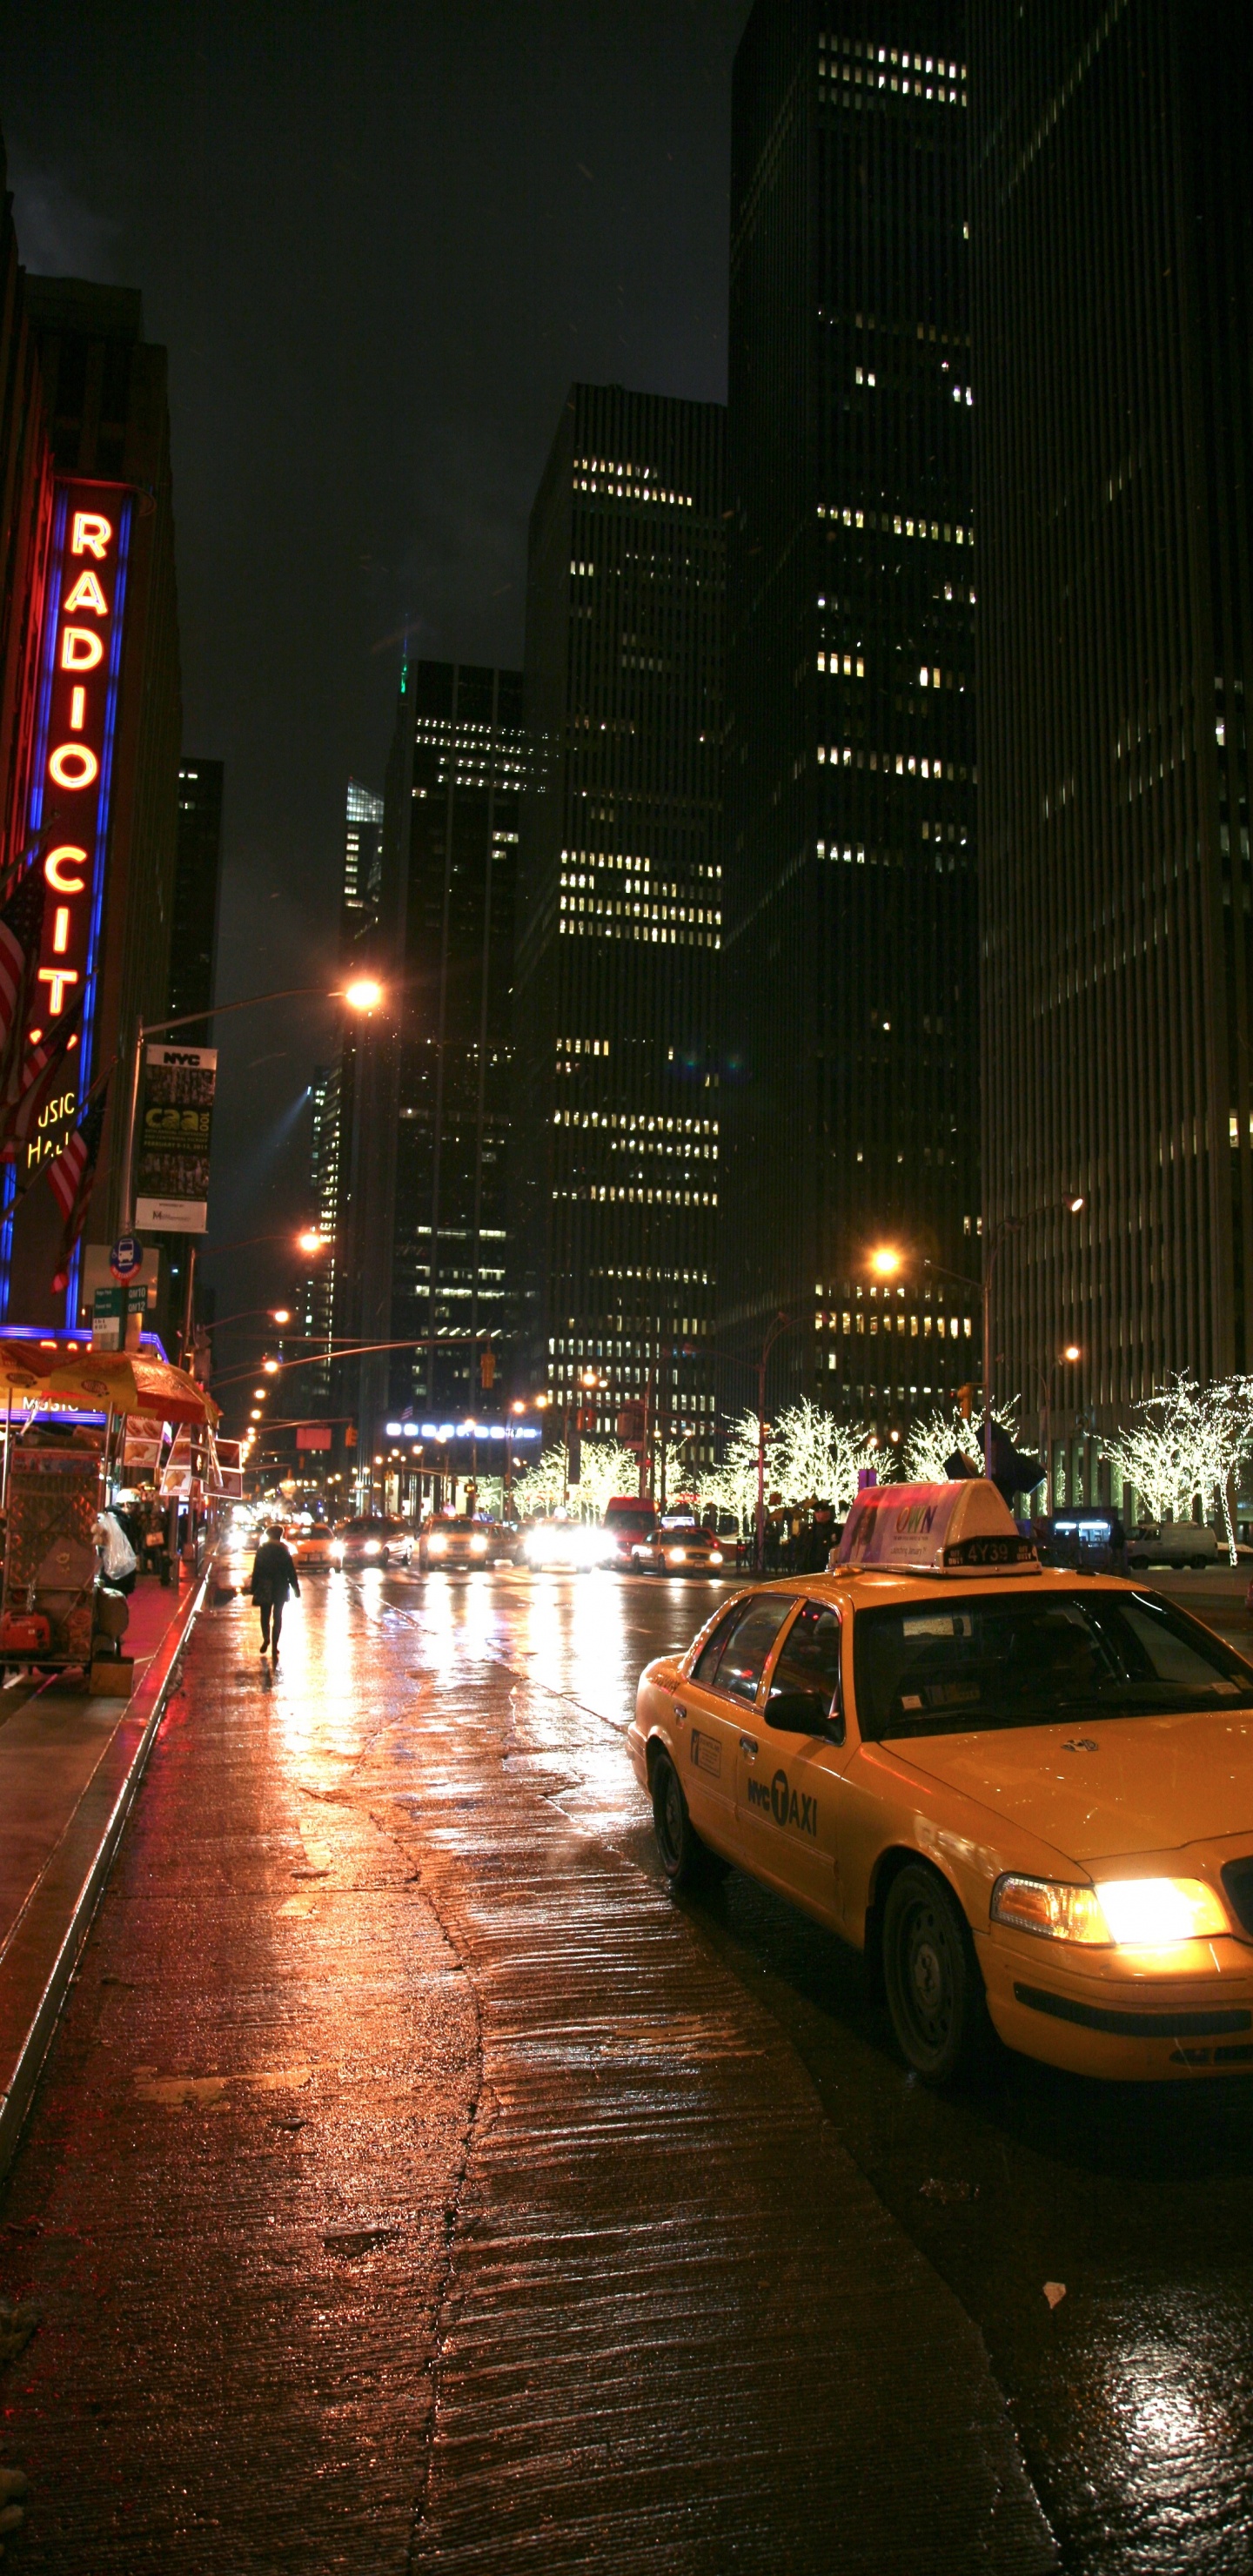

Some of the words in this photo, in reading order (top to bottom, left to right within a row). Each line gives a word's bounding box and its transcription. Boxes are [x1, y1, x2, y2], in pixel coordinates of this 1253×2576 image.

[50, 510, 112, 791] RADIO
[28, 844, 88, 1051] CIT
[163, 1051, 200, 1066] NYC
[37, 1091, 76, 1128] USIC
[145, 1108, 199, 1131] caa
[199, 1111, 210, 1131] 100
[128, 1287, 146, 1298] QM10
[128, 1301, 145, 1312] QM12
[895, 1506, 938, 1534] OWN
[968, 1543, 1008, 1561] 4Y39
[748, 1776, 770, 1811] NYC
[772, 1770, 818, 1838] TAXI
